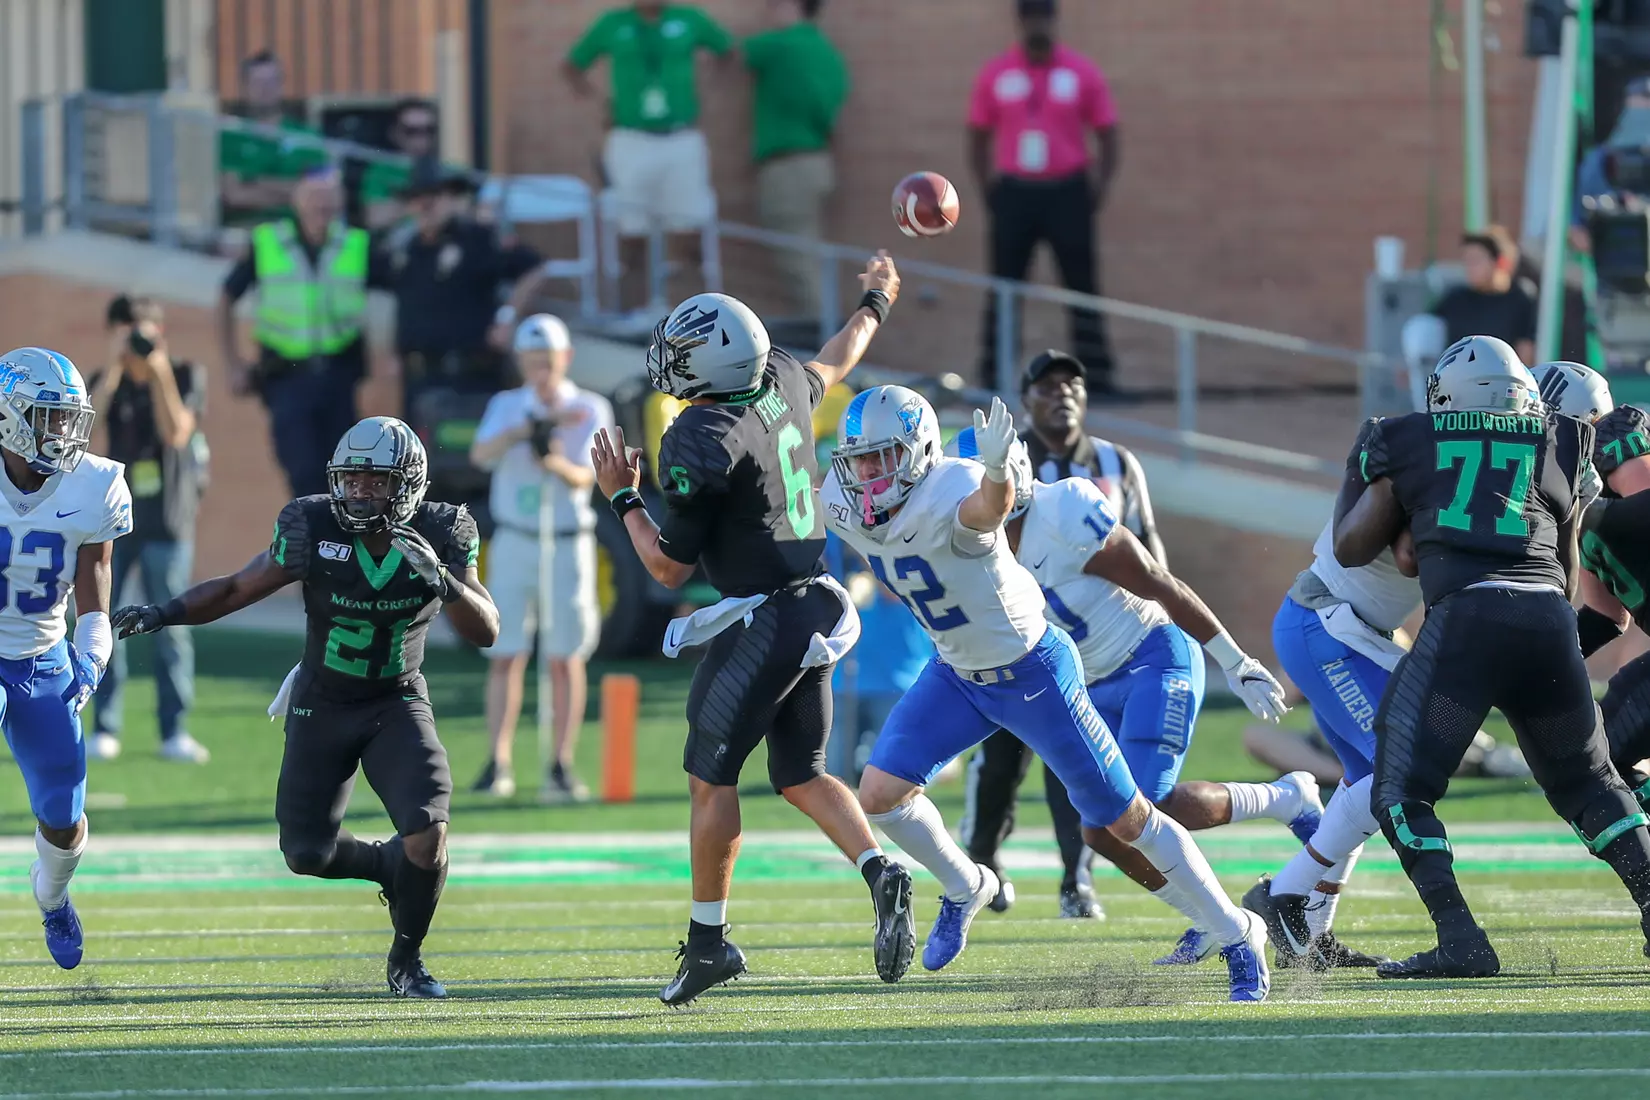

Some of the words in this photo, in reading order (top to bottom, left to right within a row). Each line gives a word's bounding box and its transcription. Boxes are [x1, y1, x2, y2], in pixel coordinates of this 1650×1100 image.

[754, 387, 789, 426] FINE
[1432, 411, 1543, 435] WOODWORTH
[670, 466, 690, 495] 6
[778, 421, 815, 540] 6
[1436, 440, 1537, 537] 77
[828, 502, 849, 522] 150
[318, 540, 352, 561] 150
[331, 592, 373, 611] MEAN
[376, 596, 423, 611] GREEN
[868, 553, 970, 631] 12
[324, 616, 413, 677] 21
[292, 706, 312, 716] UNT
[1322, 658, 1375, 732] RAIDERS
[1157, 678, 1190, 758] RAIDERS
